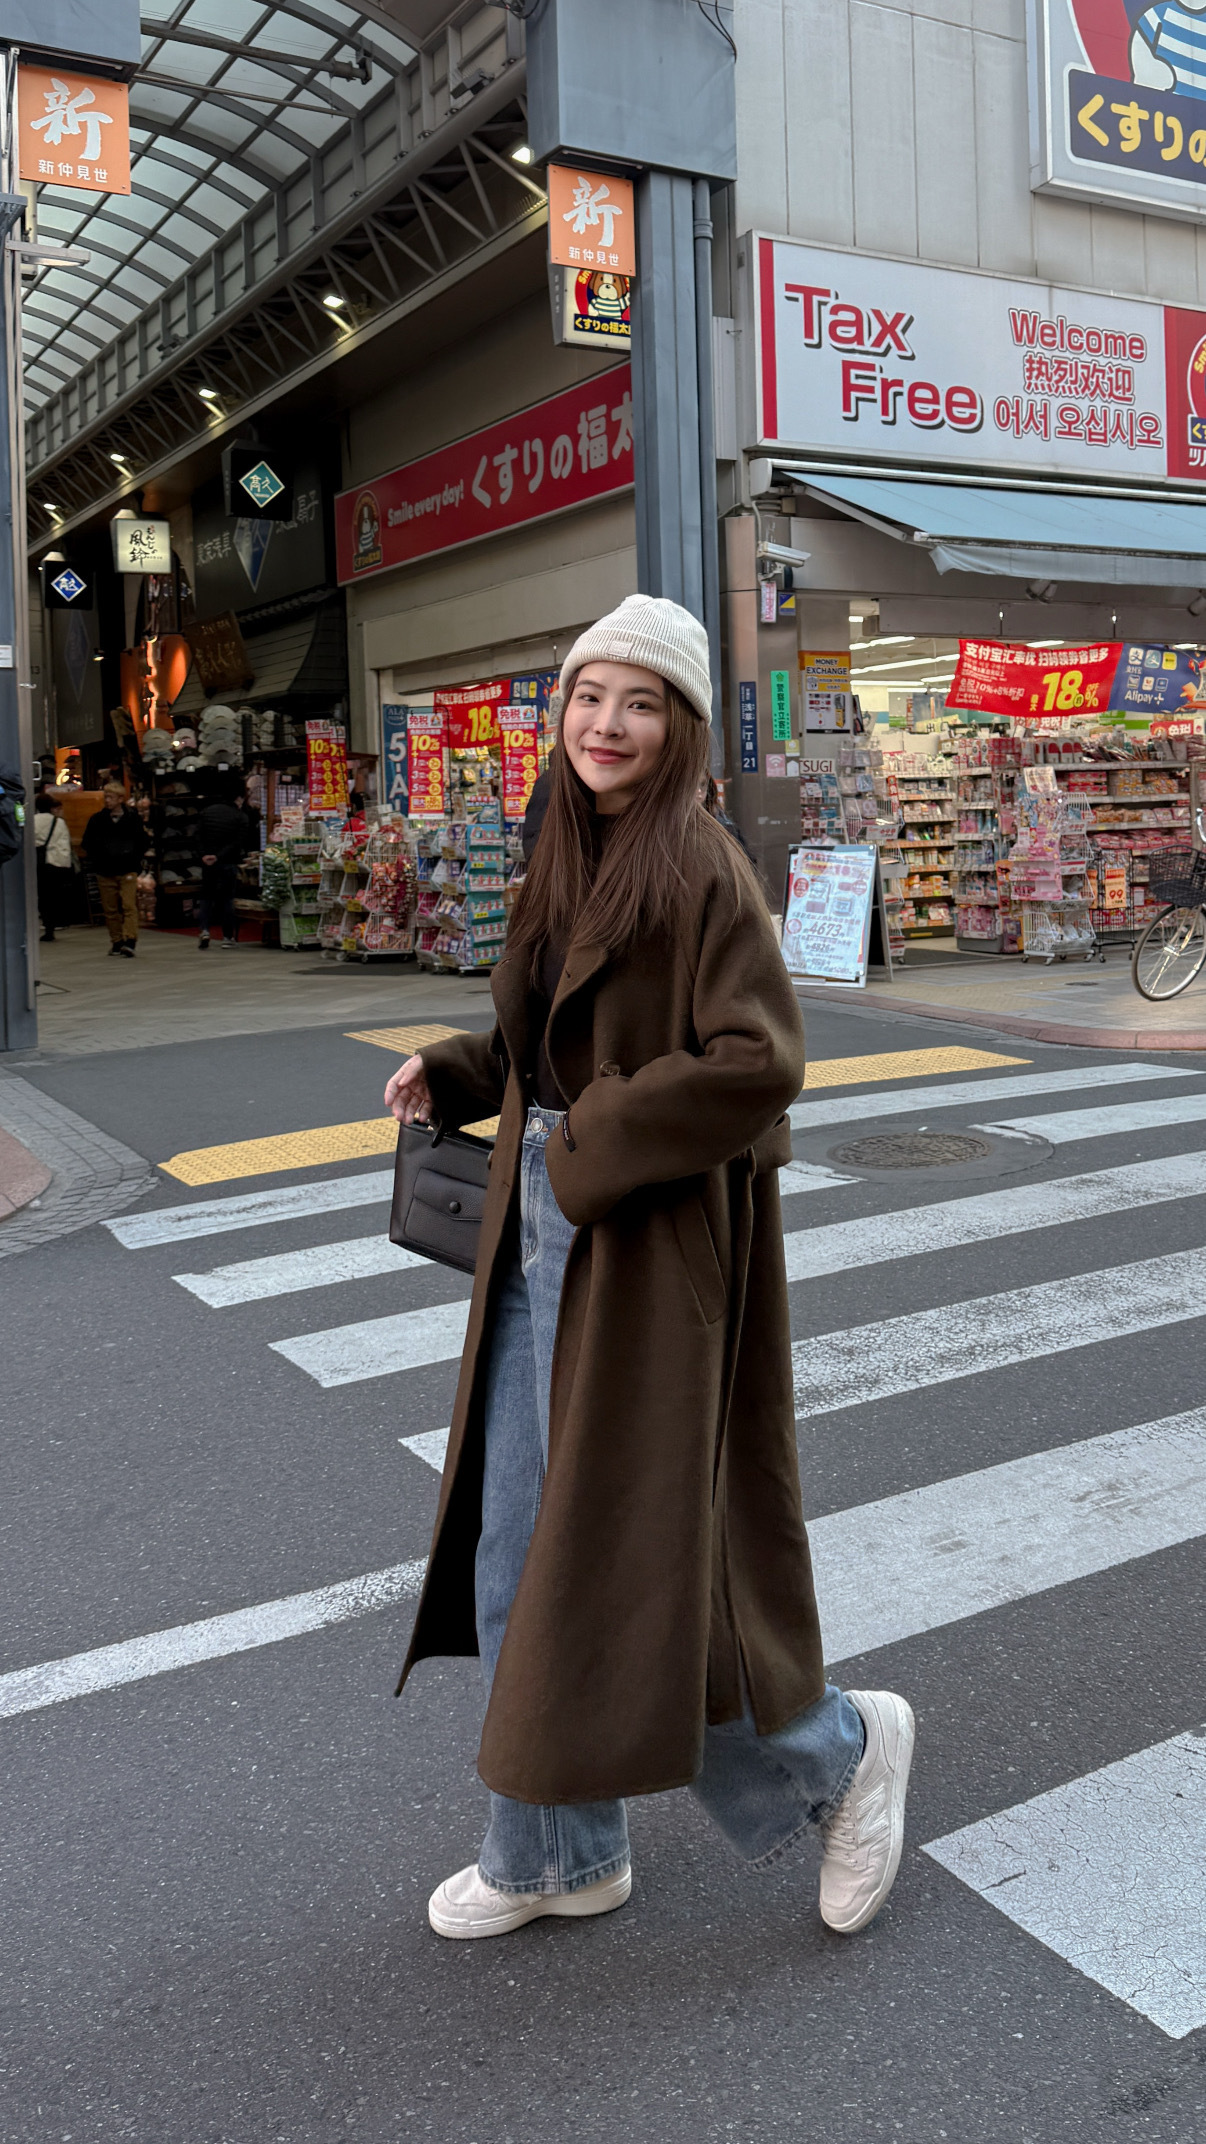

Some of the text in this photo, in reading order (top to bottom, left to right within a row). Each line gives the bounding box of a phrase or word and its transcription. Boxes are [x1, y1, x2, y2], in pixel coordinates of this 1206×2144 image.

[30, 77, 113, 161] 新
[38, 159, 109, 183] 新仲見世
[562, 176, 623, 247] 新
[568, 246, 620, 267] 新仲見世
[784, 282, 913, 358] Tax
[1009, 307, 1147, 363] Welcome
[841, 359, 982, 431] Free
[1023, 353, 1135, 405] 热烈欢迎
[994, 396, 1165, 449] 어서 오십시오
[387, 479, 465, 528] Smile every day!
[806, 666, 848, 675] EXCHANGE
[815, 658, 838, 666] MONEY
[409, 715, 428, 725] 免税
[499, 708, 521, 720] 免税
[776, 683, 787, 739] 警察官立寄所
[743, 757, 756, 768] 21
[1109, 889, 1124, 899] 99
